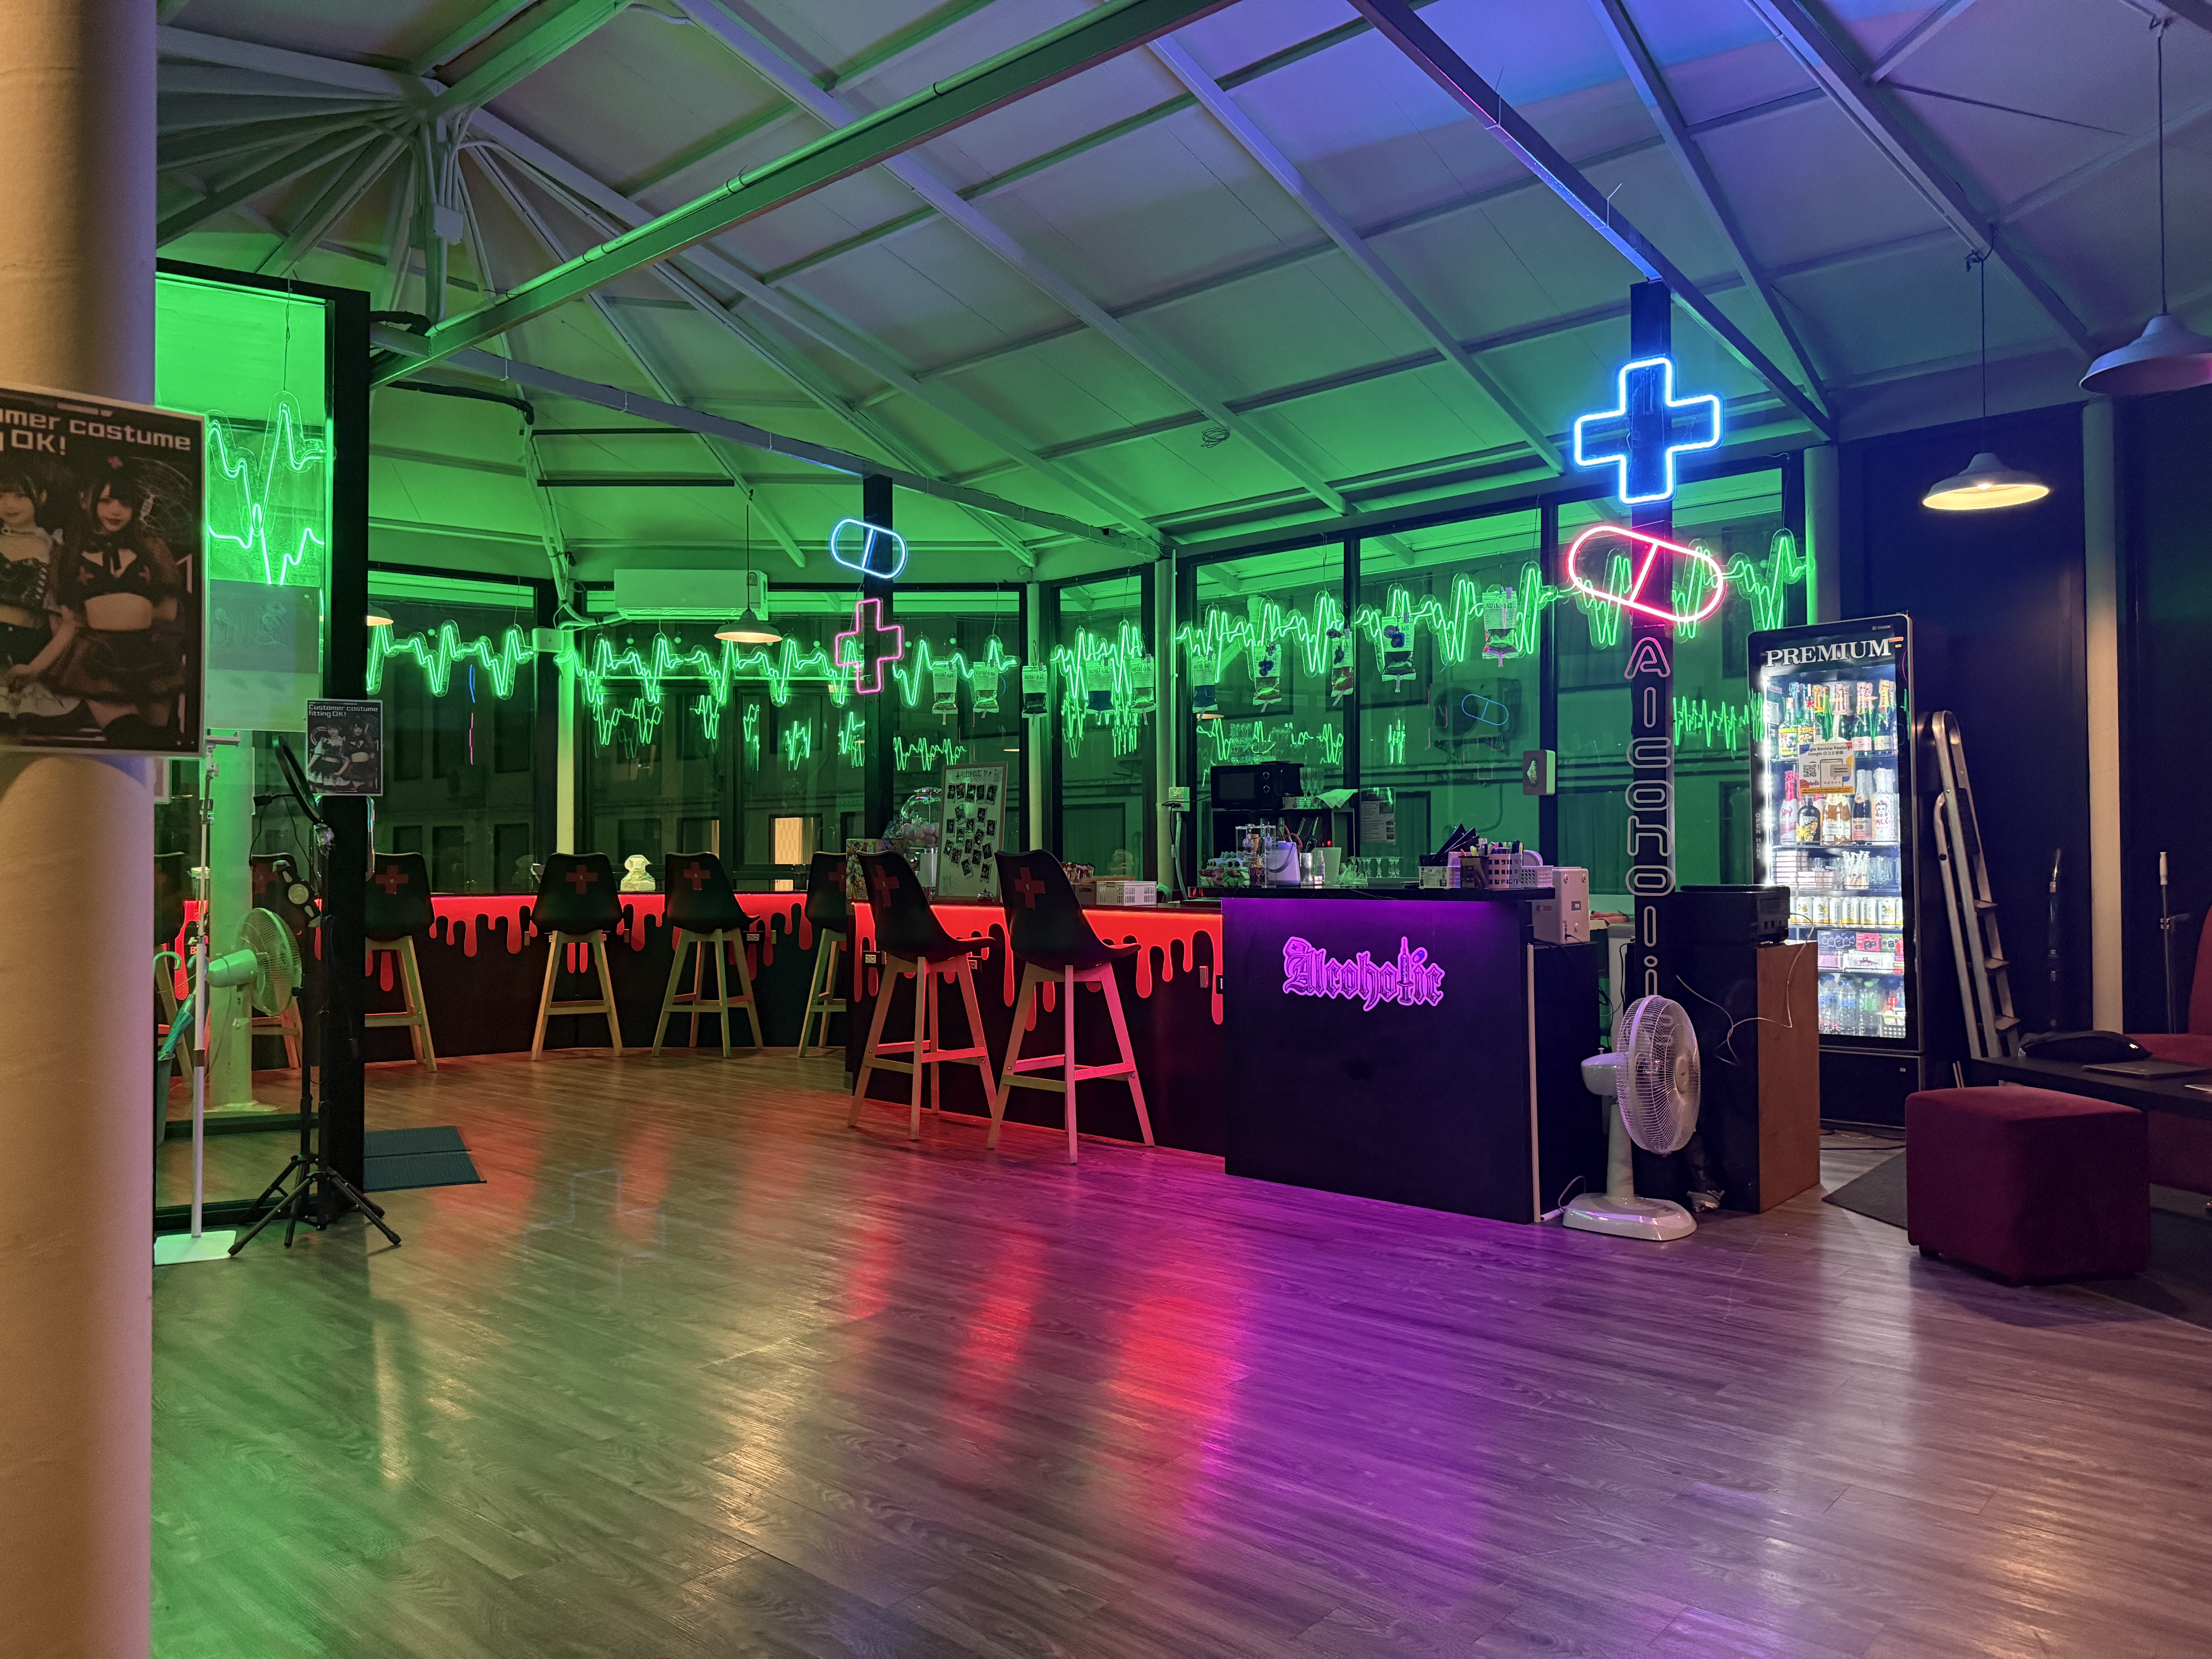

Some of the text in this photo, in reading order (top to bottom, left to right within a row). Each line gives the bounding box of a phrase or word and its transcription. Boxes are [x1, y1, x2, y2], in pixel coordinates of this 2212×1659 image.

[0, 409, 191, 451] mer costume
[11, 429, 66, 455] OK!
[1765, 638, 1891, 667] PREMIUM
[1283, 936, 1446, 1012] Alcoholic
